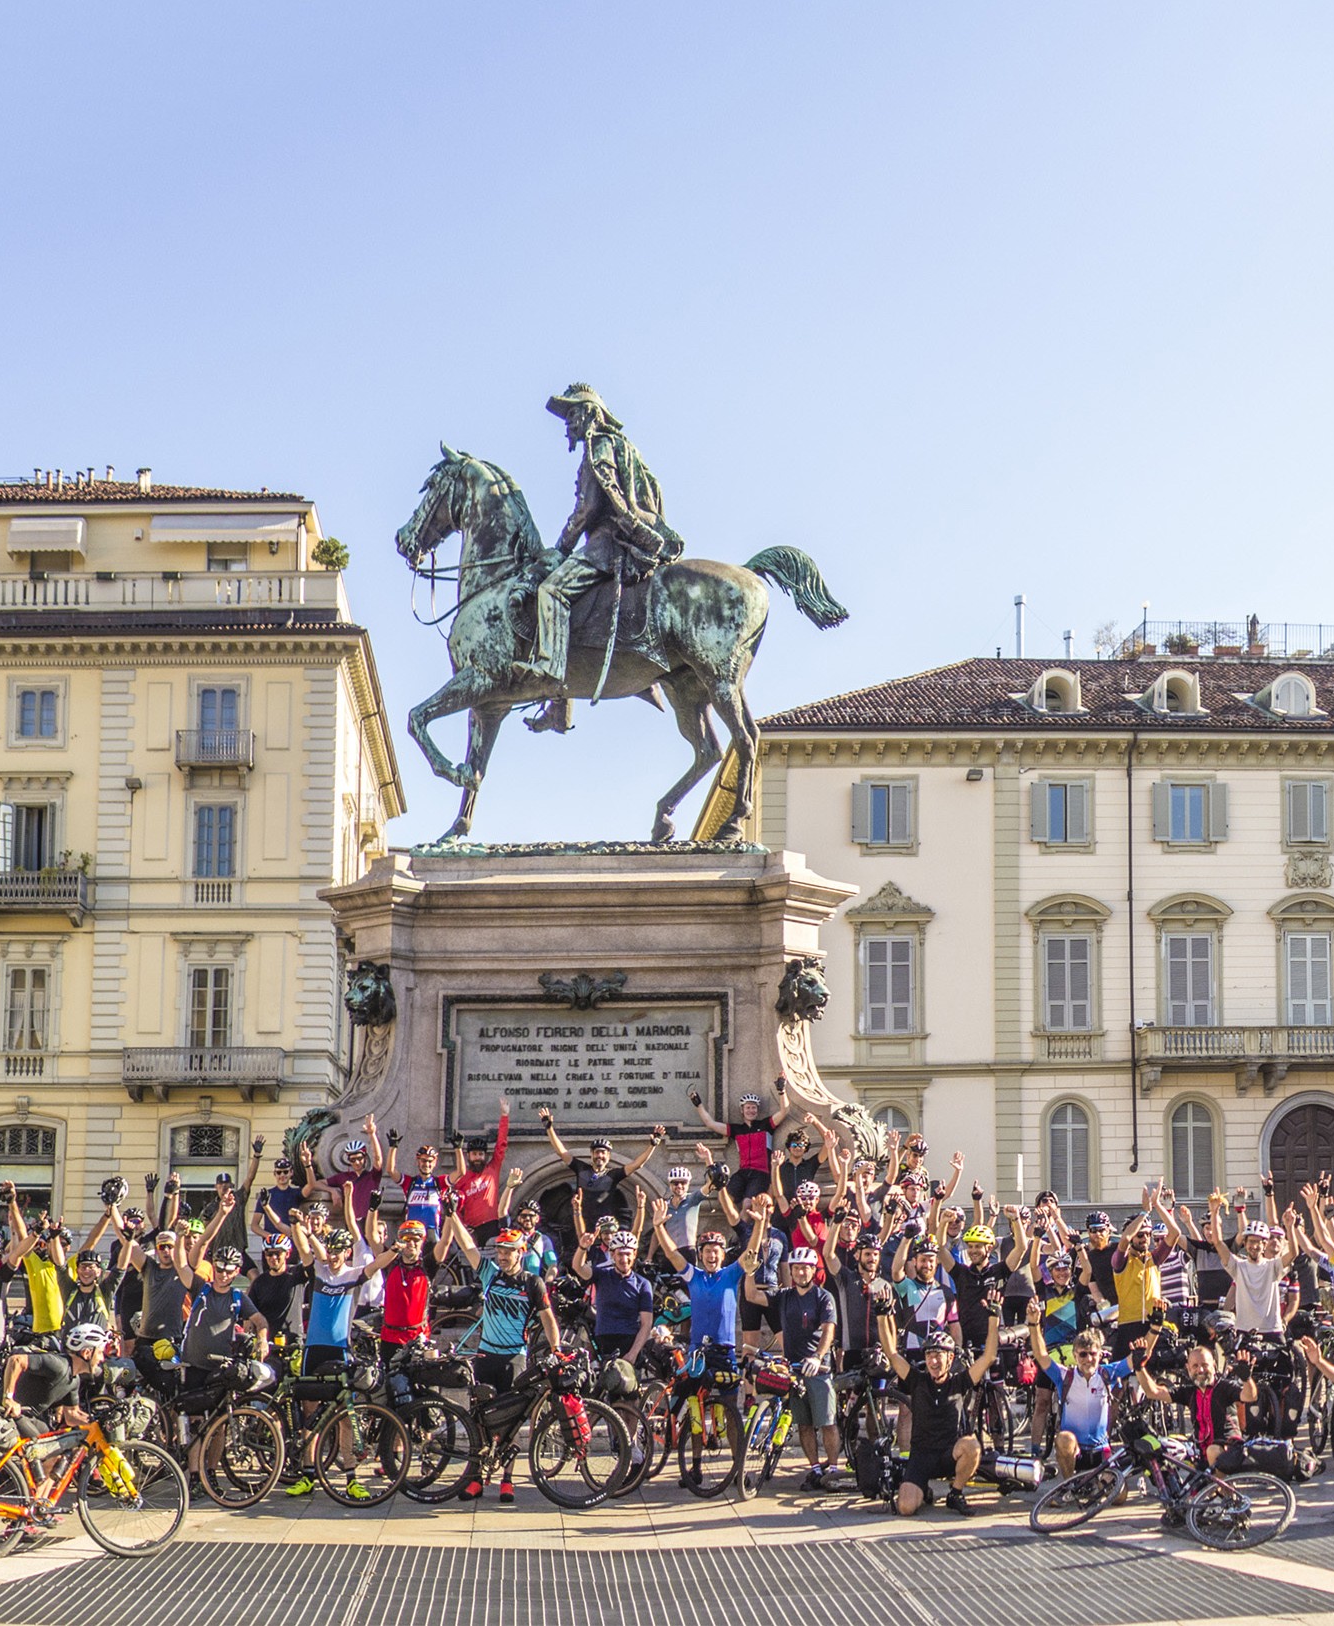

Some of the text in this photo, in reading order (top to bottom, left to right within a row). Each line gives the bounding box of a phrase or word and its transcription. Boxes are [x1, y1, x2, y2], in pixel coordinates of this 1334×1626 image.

[479, 1026, 690, 1038] ALFONSO FERRERO DELLA MARMORA
[646, 1042, 689, 1050] NAZIONALE
[566, 1073, 594, 1081] CRIMEA
[602, 1072, 612, 1080] LE
[619, 1072, 655, 1080] FORTUNE
[504, 1088, 559, 1096] CONTINUANDO
[579, 1087, 598, 1095] CAPO
[628, 1086, 664, 1094] GOVERNO
[532, 1102, 556, 1110] OPERA
[564, 1101, 571, 1109] DI
[578, 1101, 610, 1109] CAMILLO
[618, 1100, 648, 1108] CAVOUR
